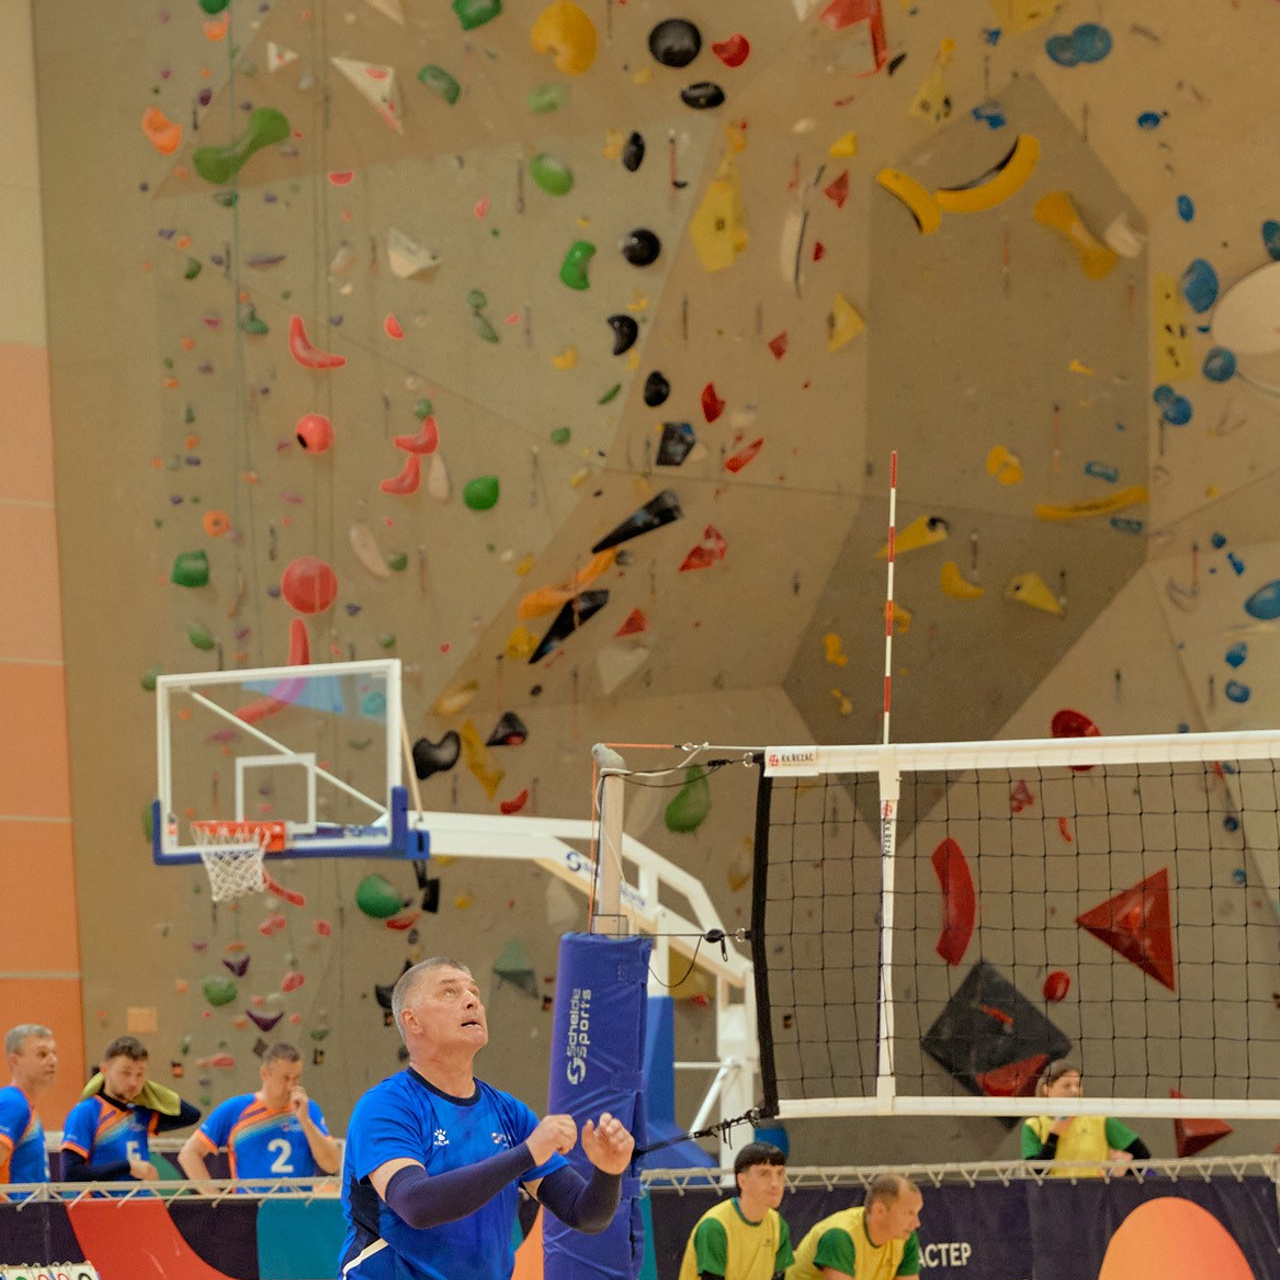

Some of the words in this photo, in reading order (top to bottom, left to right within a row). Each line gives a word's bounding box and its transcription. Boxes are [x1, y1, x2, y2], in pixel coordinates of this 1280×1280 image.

[578, 988, 592, 1058] Sports
[268, 1138, 294, 1174] 2
[918, 1242, 972, 1267] АСТЕР
